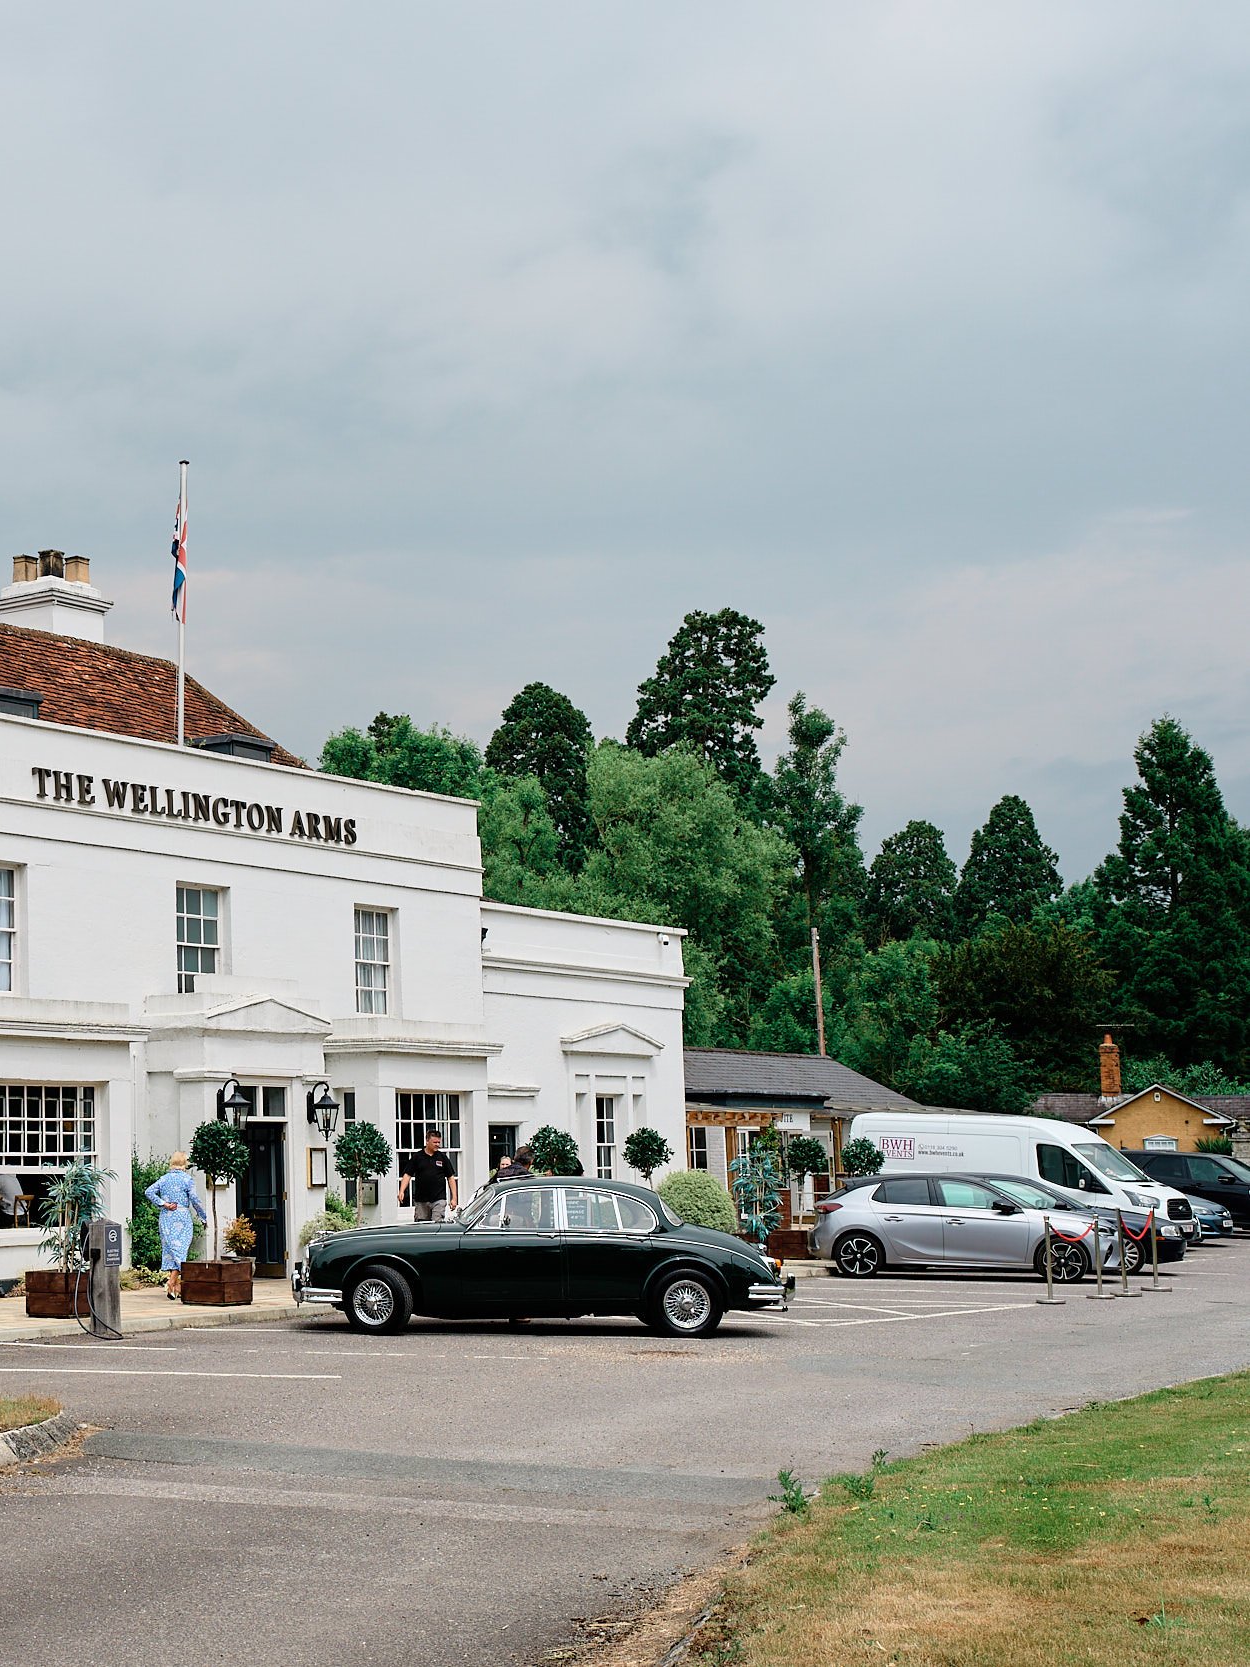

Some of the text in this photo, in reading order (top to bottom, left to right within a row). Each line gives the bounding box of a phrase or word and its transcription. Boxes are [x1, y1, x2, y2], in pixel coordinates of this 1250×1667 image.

[32, 766, 358, 845] THE WELLINGTON ARMS
[882, 1138, 913, 1151] BWH
